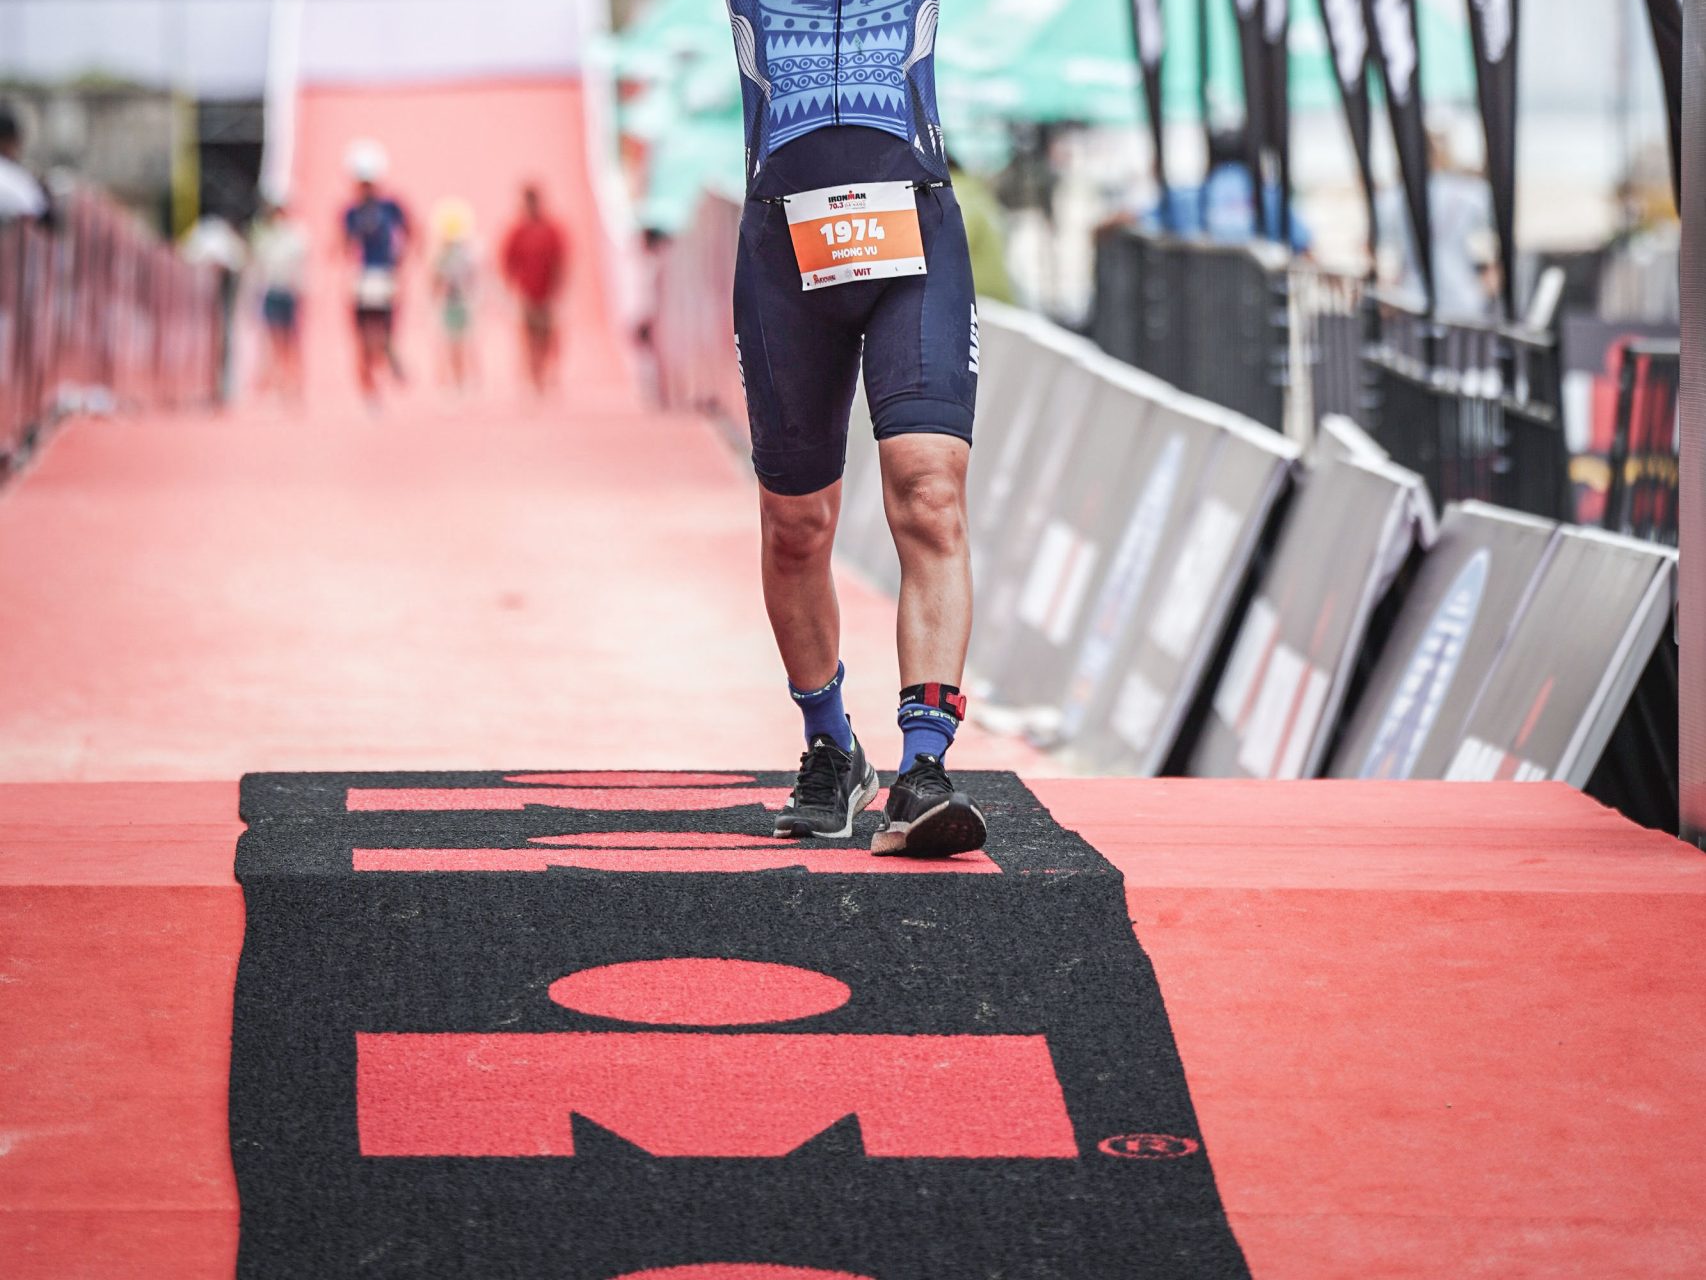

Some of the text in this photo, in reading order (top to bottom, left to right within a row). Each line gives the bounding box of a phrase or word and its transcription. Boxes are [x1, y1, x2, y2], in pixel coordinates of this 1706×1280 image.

[828, 191, 866, 203] IRONMAN
[829, 202, 844, 210] 70.3
[820, 218, 885, 245] 1974
[832, 246, 878, 260] PHONG VU
[853, 268, 871, 277] WiT
